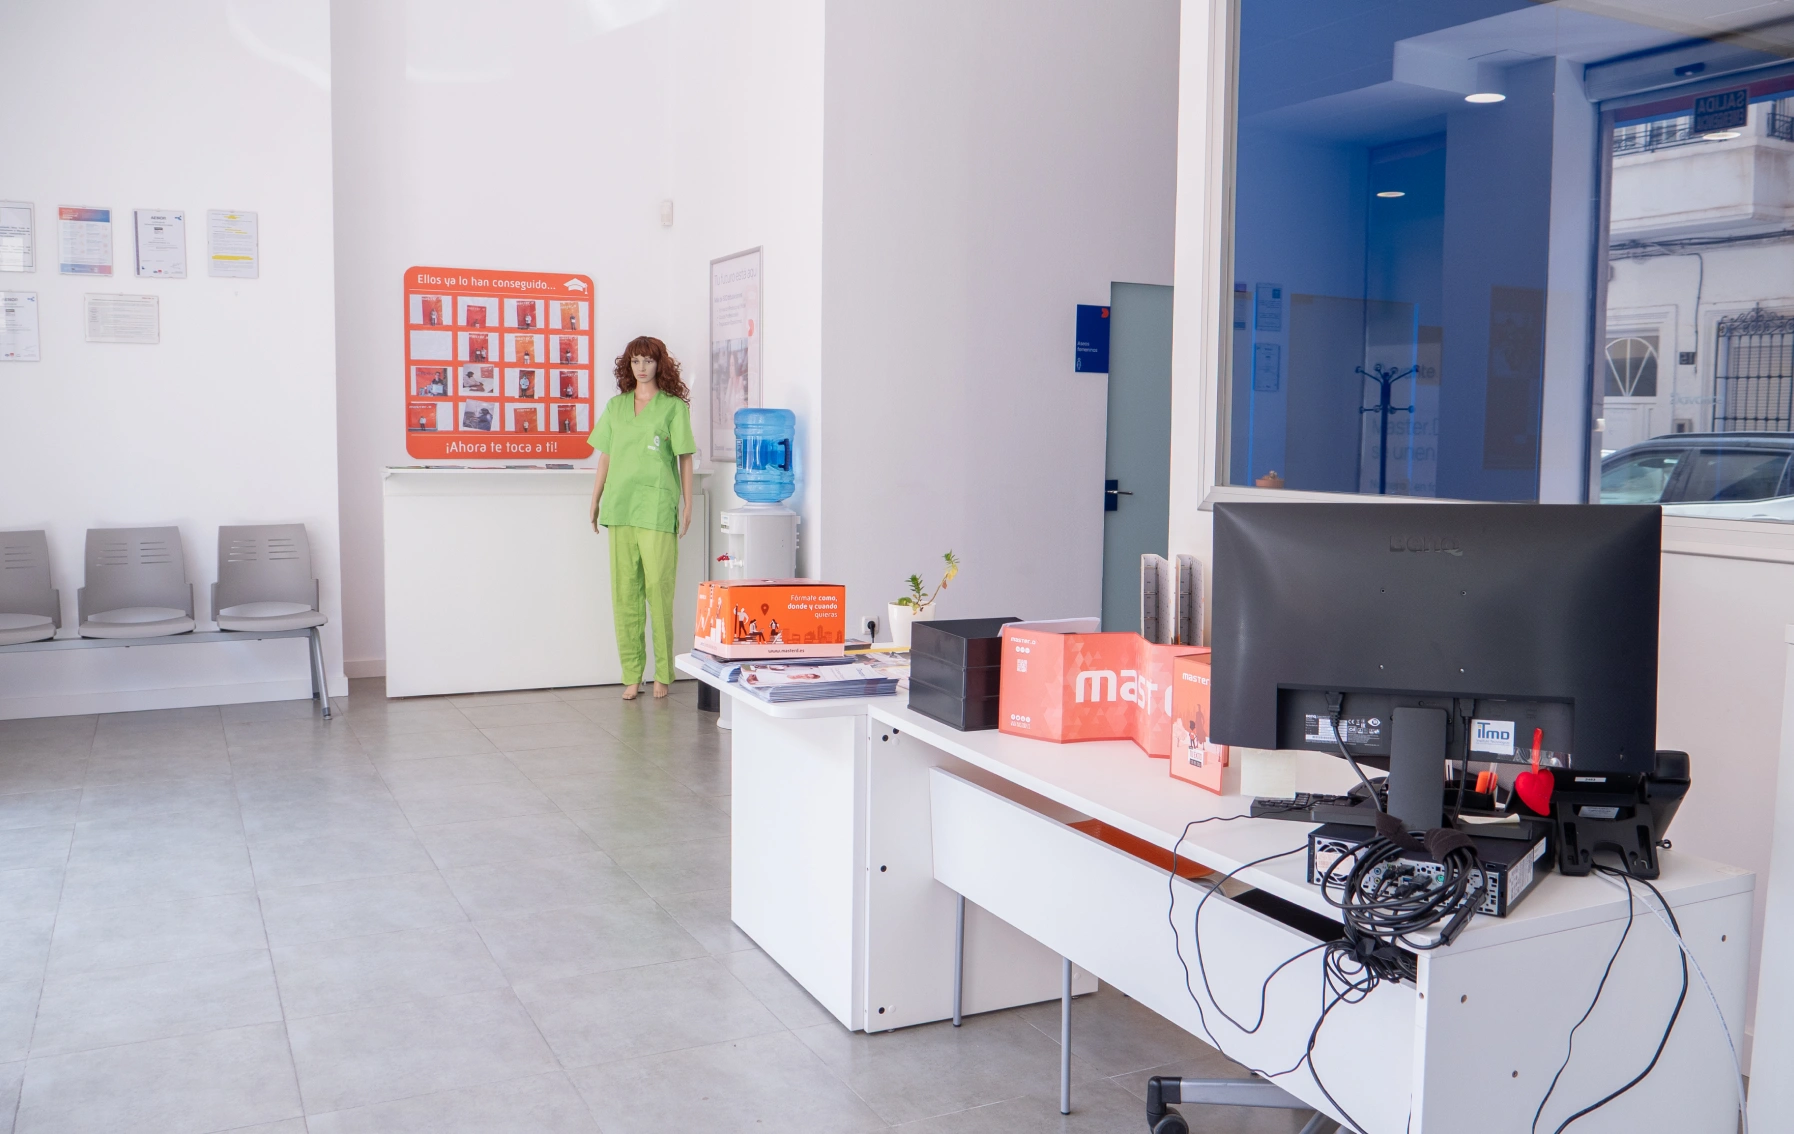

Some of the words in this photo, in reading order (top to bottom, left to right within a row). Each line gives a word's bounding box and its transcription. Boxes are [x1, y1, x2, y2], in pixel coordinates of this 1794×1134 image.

[417, 274, 442, 285] Ellos
[444, 277, 456, 286] ya
[459, 276, 468, 286] lo
[471, 276, 489, 287] han
[492, 278, 556, 290] conseguido...
[446, 441, 486, 454] ¡Ahora
[490, 442, 502, 452] te
[506, 442, 532, 452] toca
[536, 444, 542, 452] a
[546, 442, 557, 452] ti!
[1182, 672, 1210, 685] master
